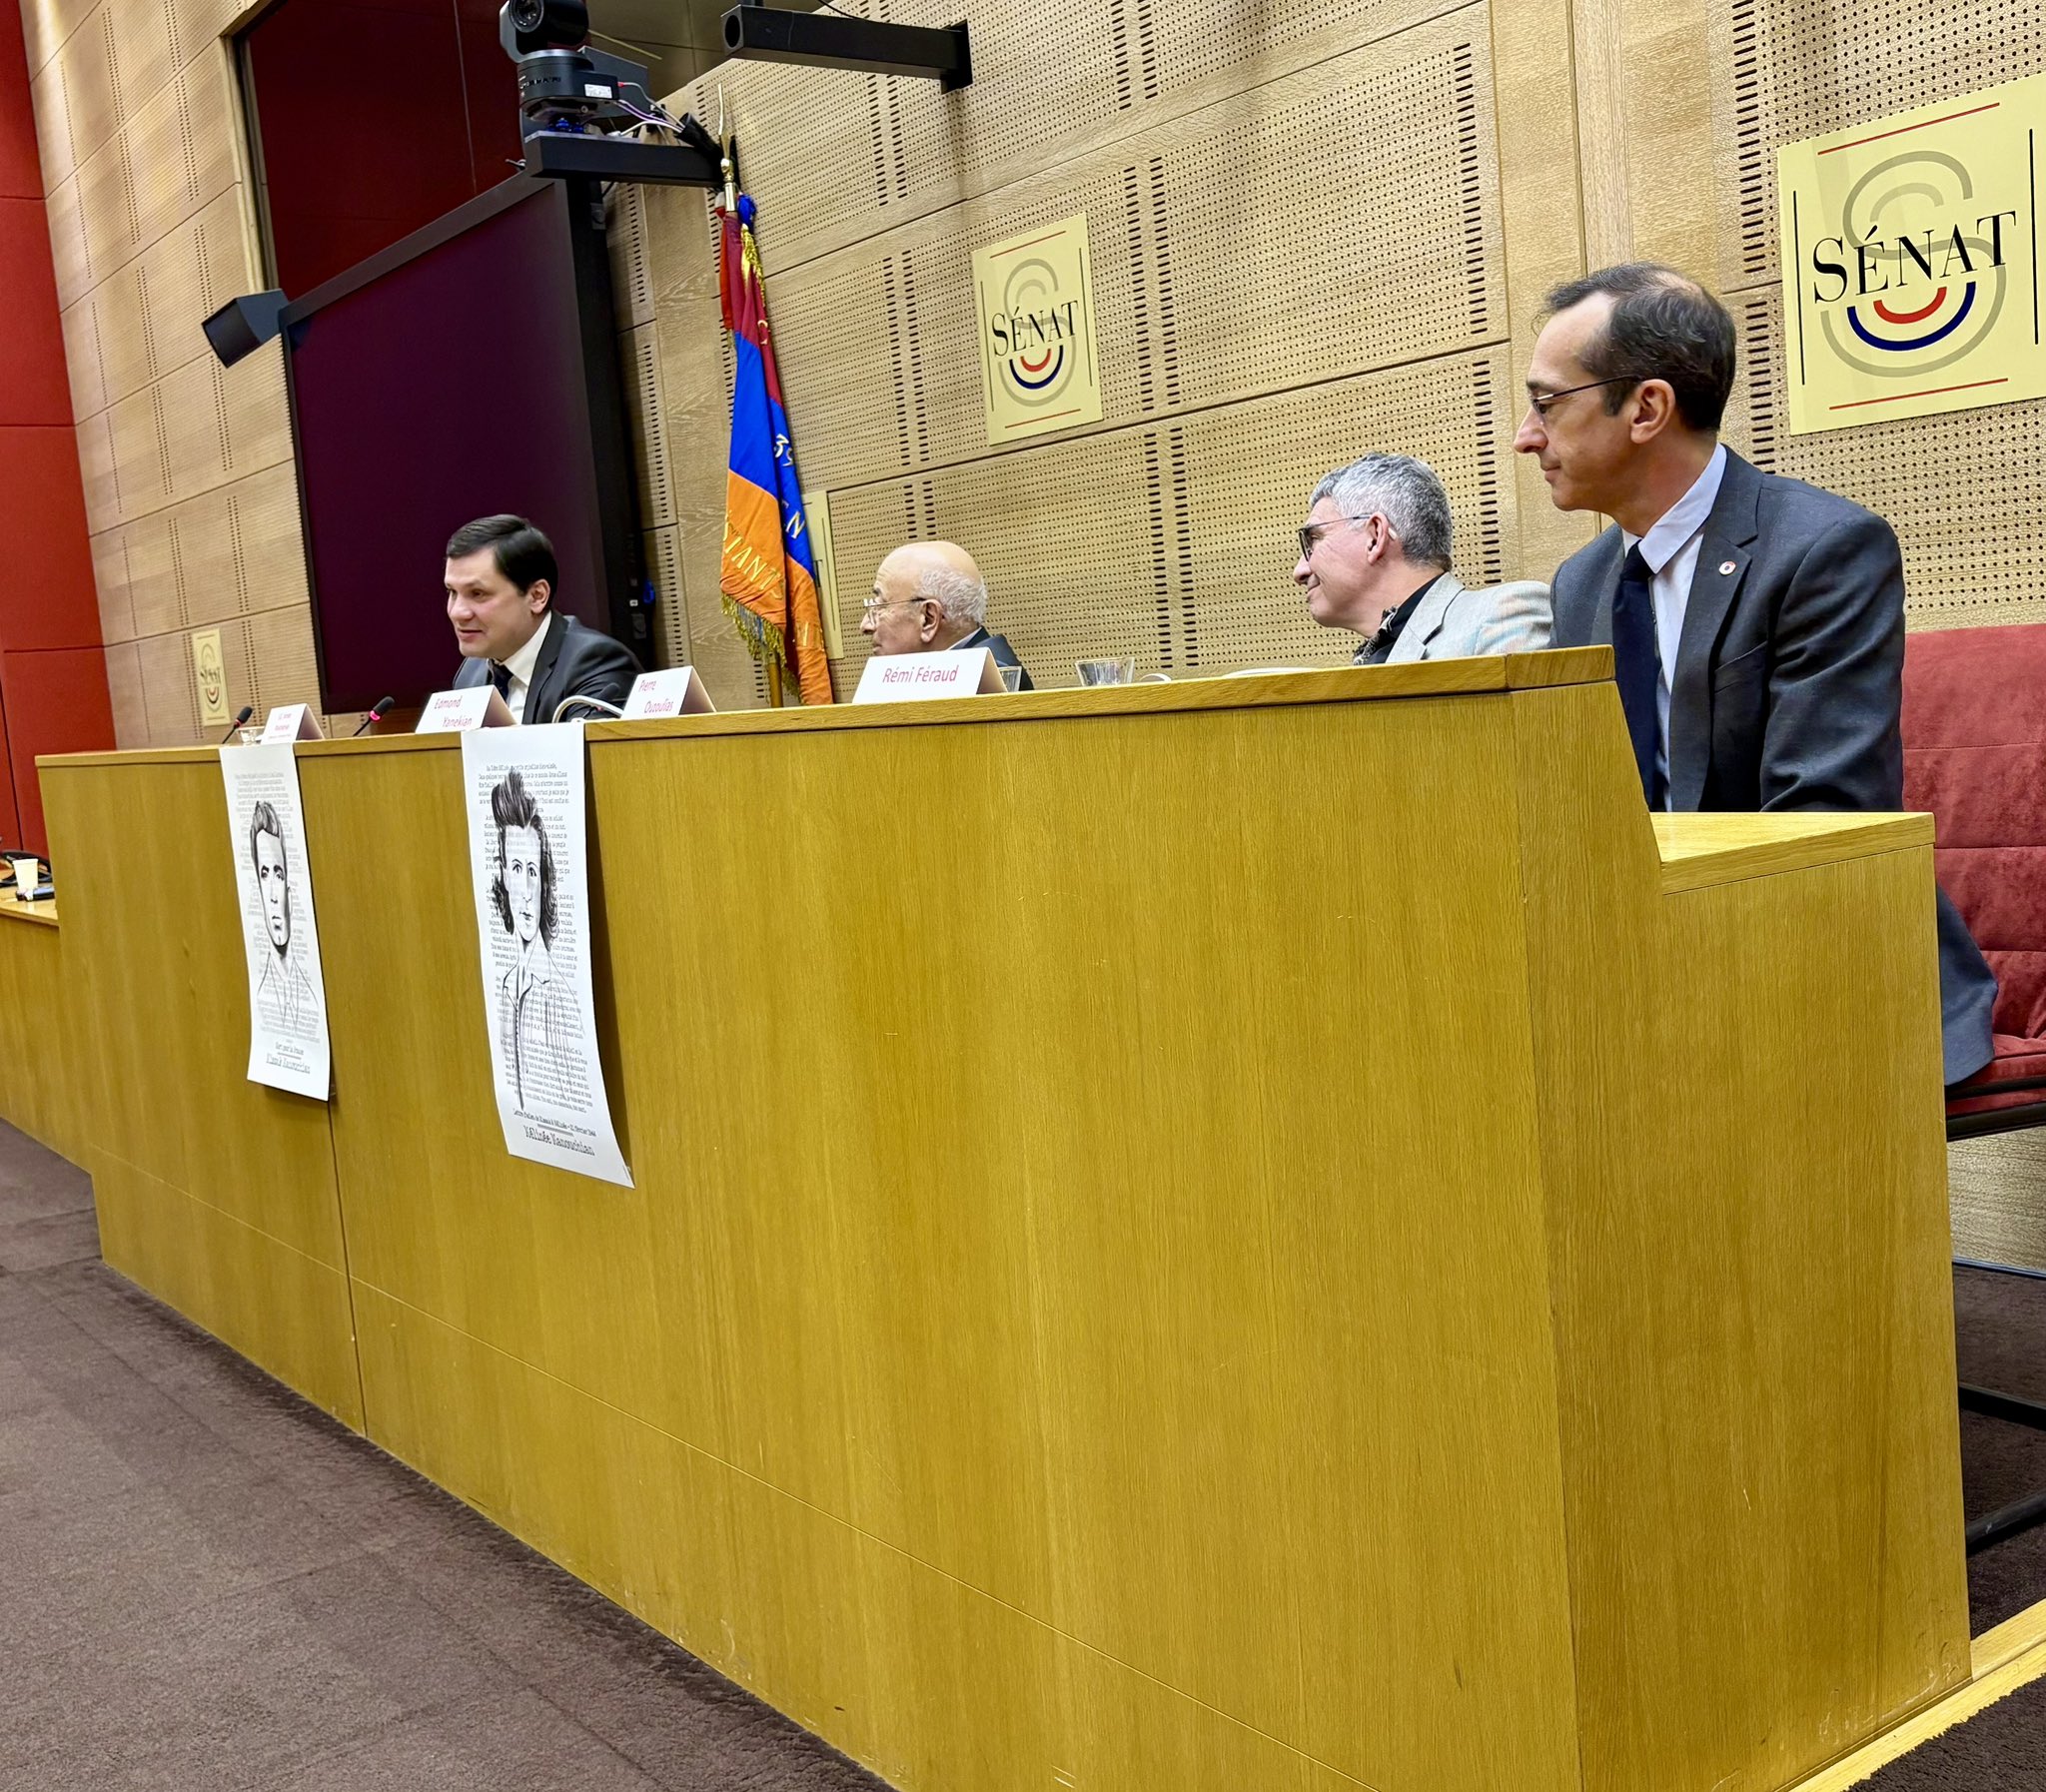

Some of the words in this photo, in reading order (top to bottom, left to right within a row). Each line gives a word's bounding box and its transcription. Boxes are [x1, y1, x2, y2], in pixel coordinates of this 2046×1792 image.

[1812, 210, 2017, 304] SÉNAT
[992, 299, 1080, 359] SÉNAT
[882, 665, 915, 683] Rémi
[914, 664, 960, 683] Féraud
